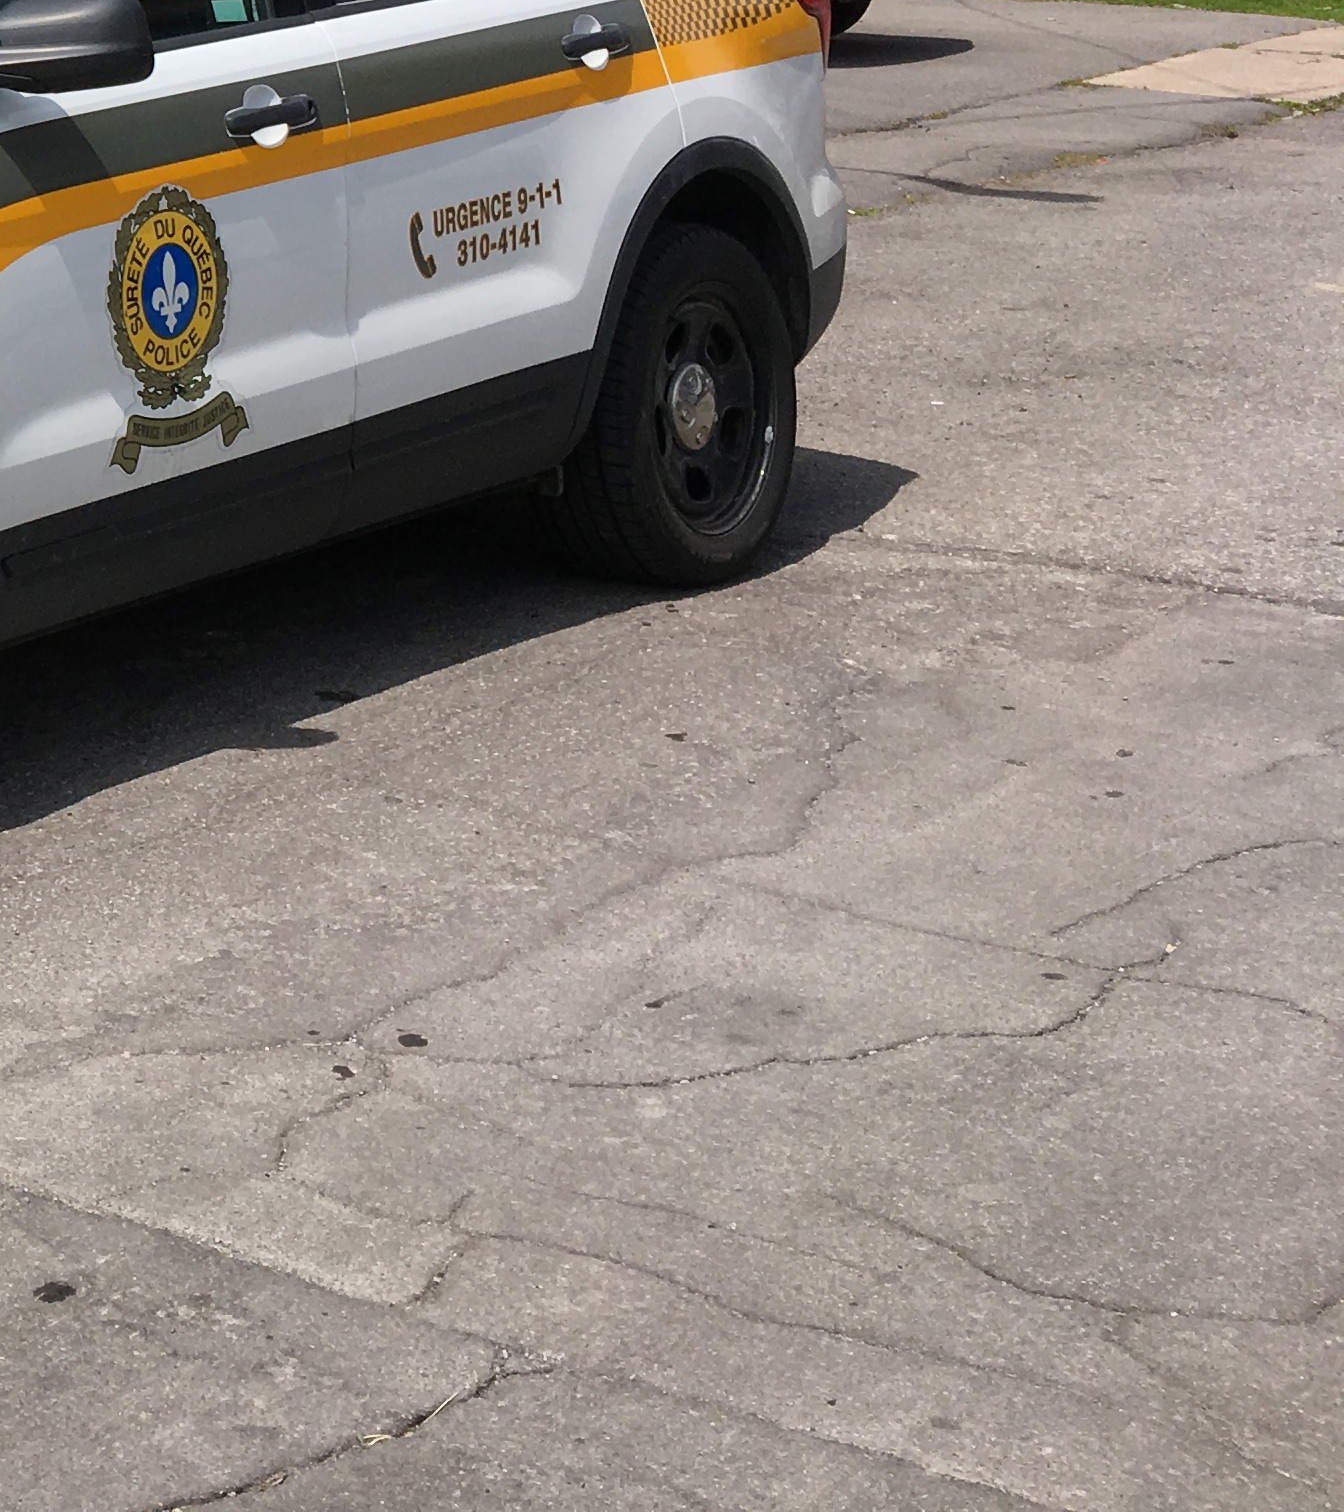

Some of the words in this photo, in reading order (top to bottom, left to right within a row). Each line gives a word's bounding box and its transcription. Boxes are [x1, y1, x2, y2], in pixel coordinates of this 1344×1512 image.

[432, 190, 512, 238] URGENCE
[517, 178, 562, 215] 9-1-1
[152, 217, 176, 241] DU
[181, 224, 214, 320] QUÉBEC
[457, 218, 541, 267] 310-4141
[142, 327, 202, 366] POLICE
